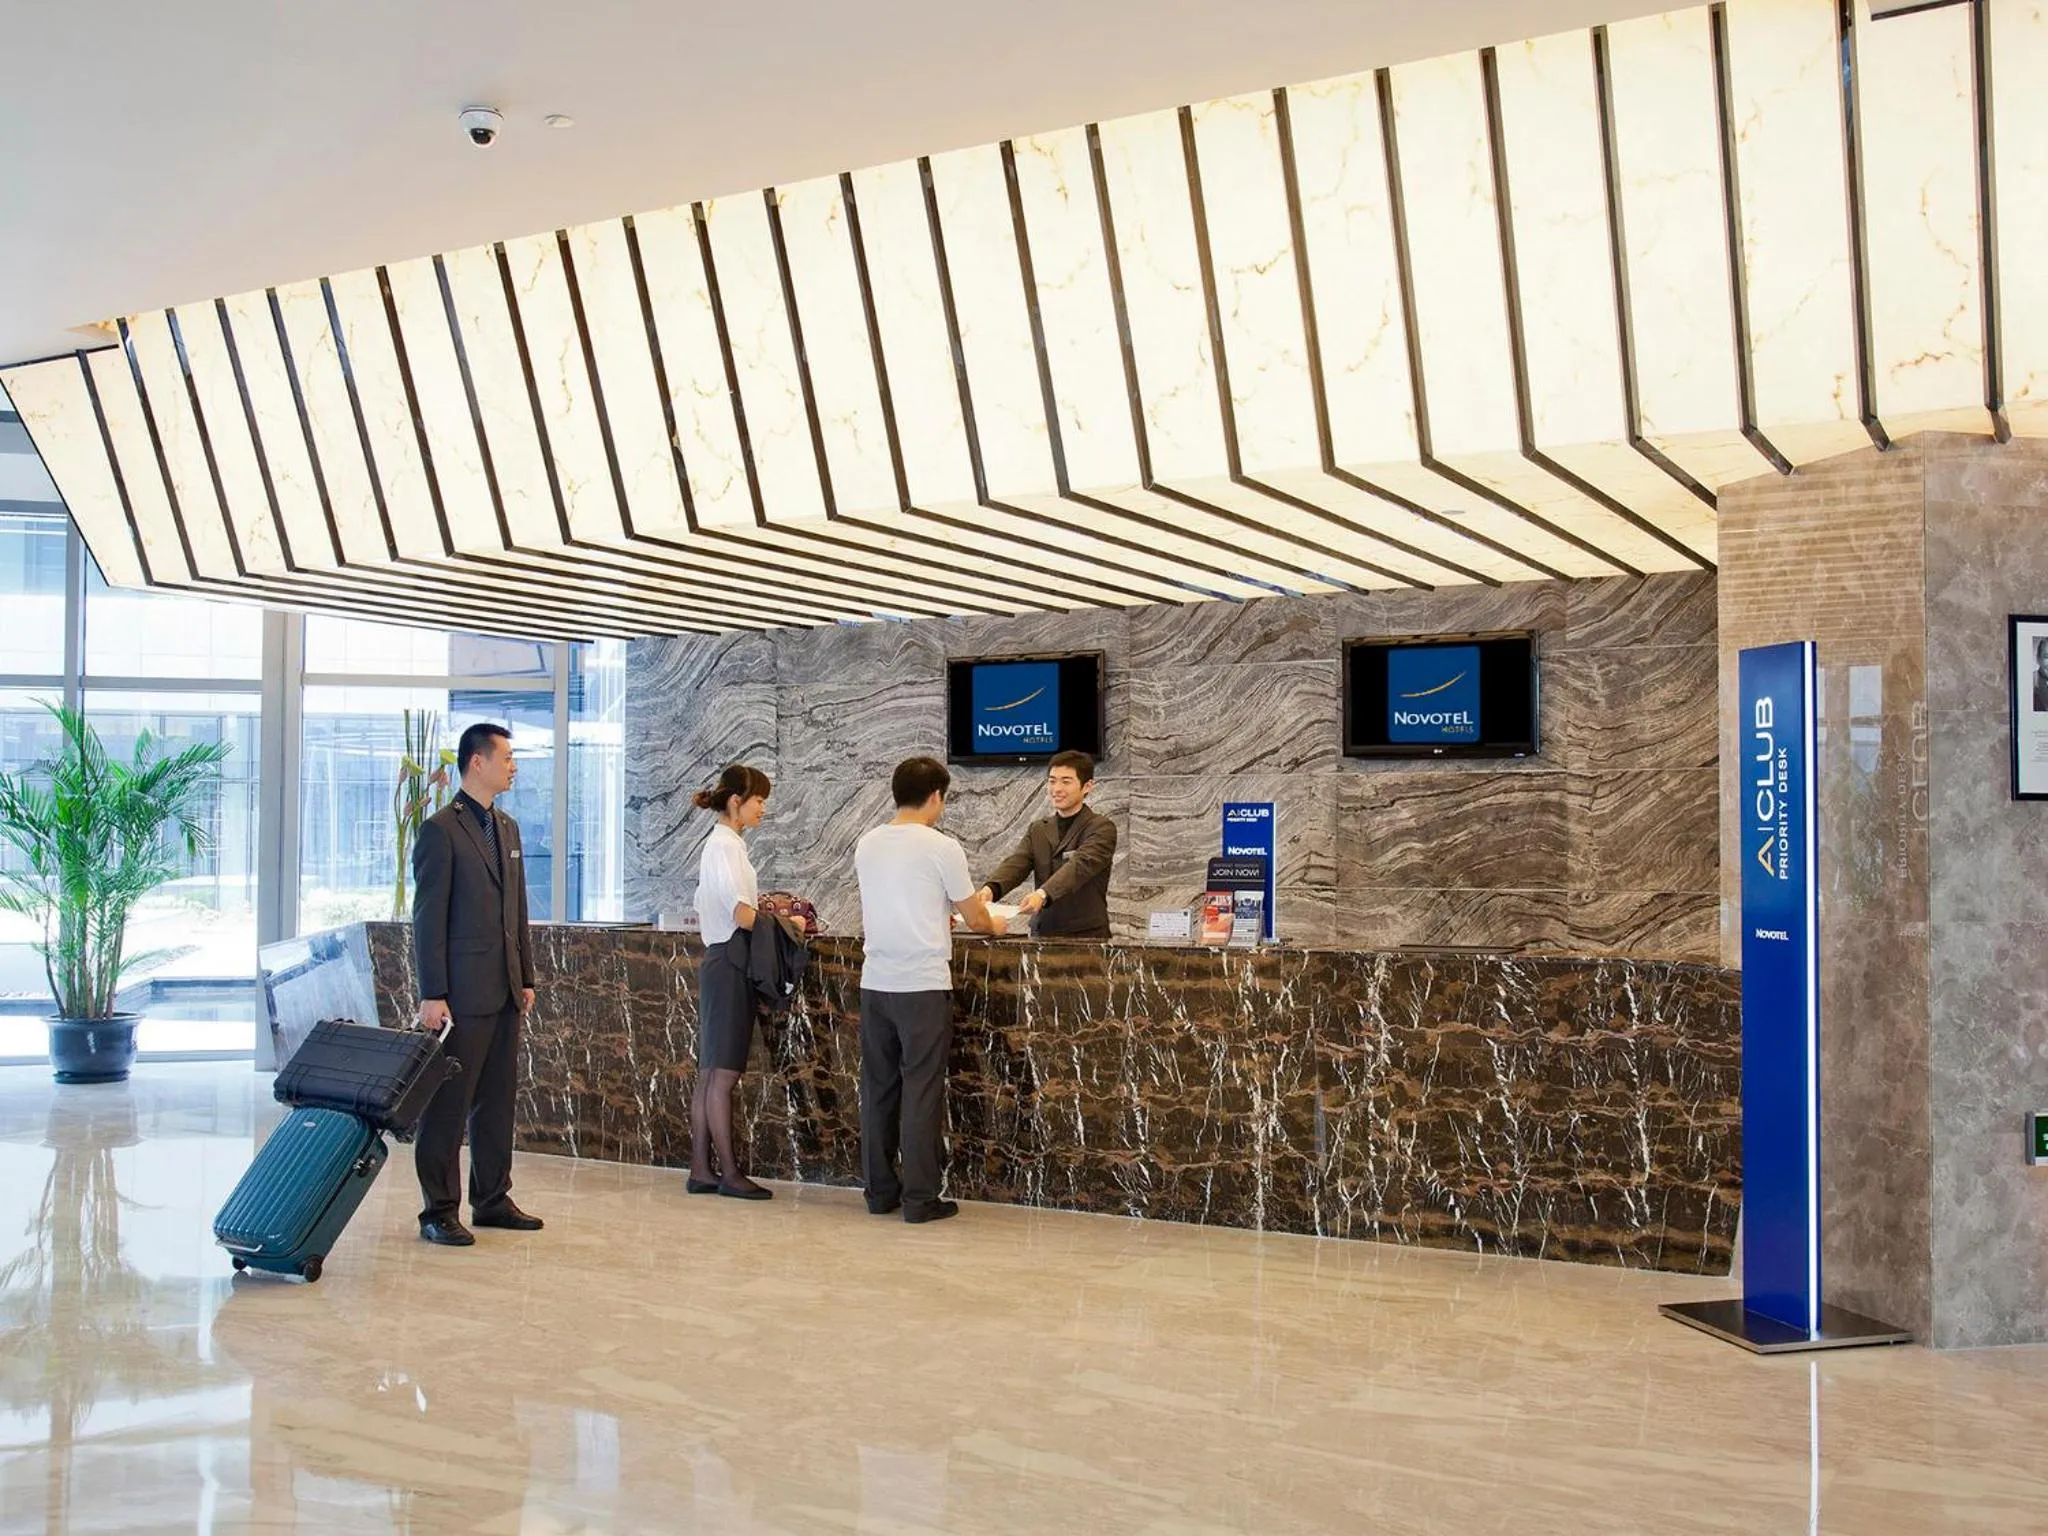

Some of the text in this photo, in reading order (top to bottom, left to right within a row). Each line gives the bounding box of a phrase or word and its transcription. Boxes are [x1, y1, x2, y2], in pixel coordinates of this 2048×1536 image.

[1394, 711, 1474, 725] NOVOTEL
[978, 722, 1053, 737] NOVOTEL
[1778, 747, 1788, 880] PRIORITY DESK
[1228, 846, 1268, 856] NOVOTEL
[1212, 868, 1234, 876] JOIN
[1755, 928, 1789, 941] NOVOTEL
